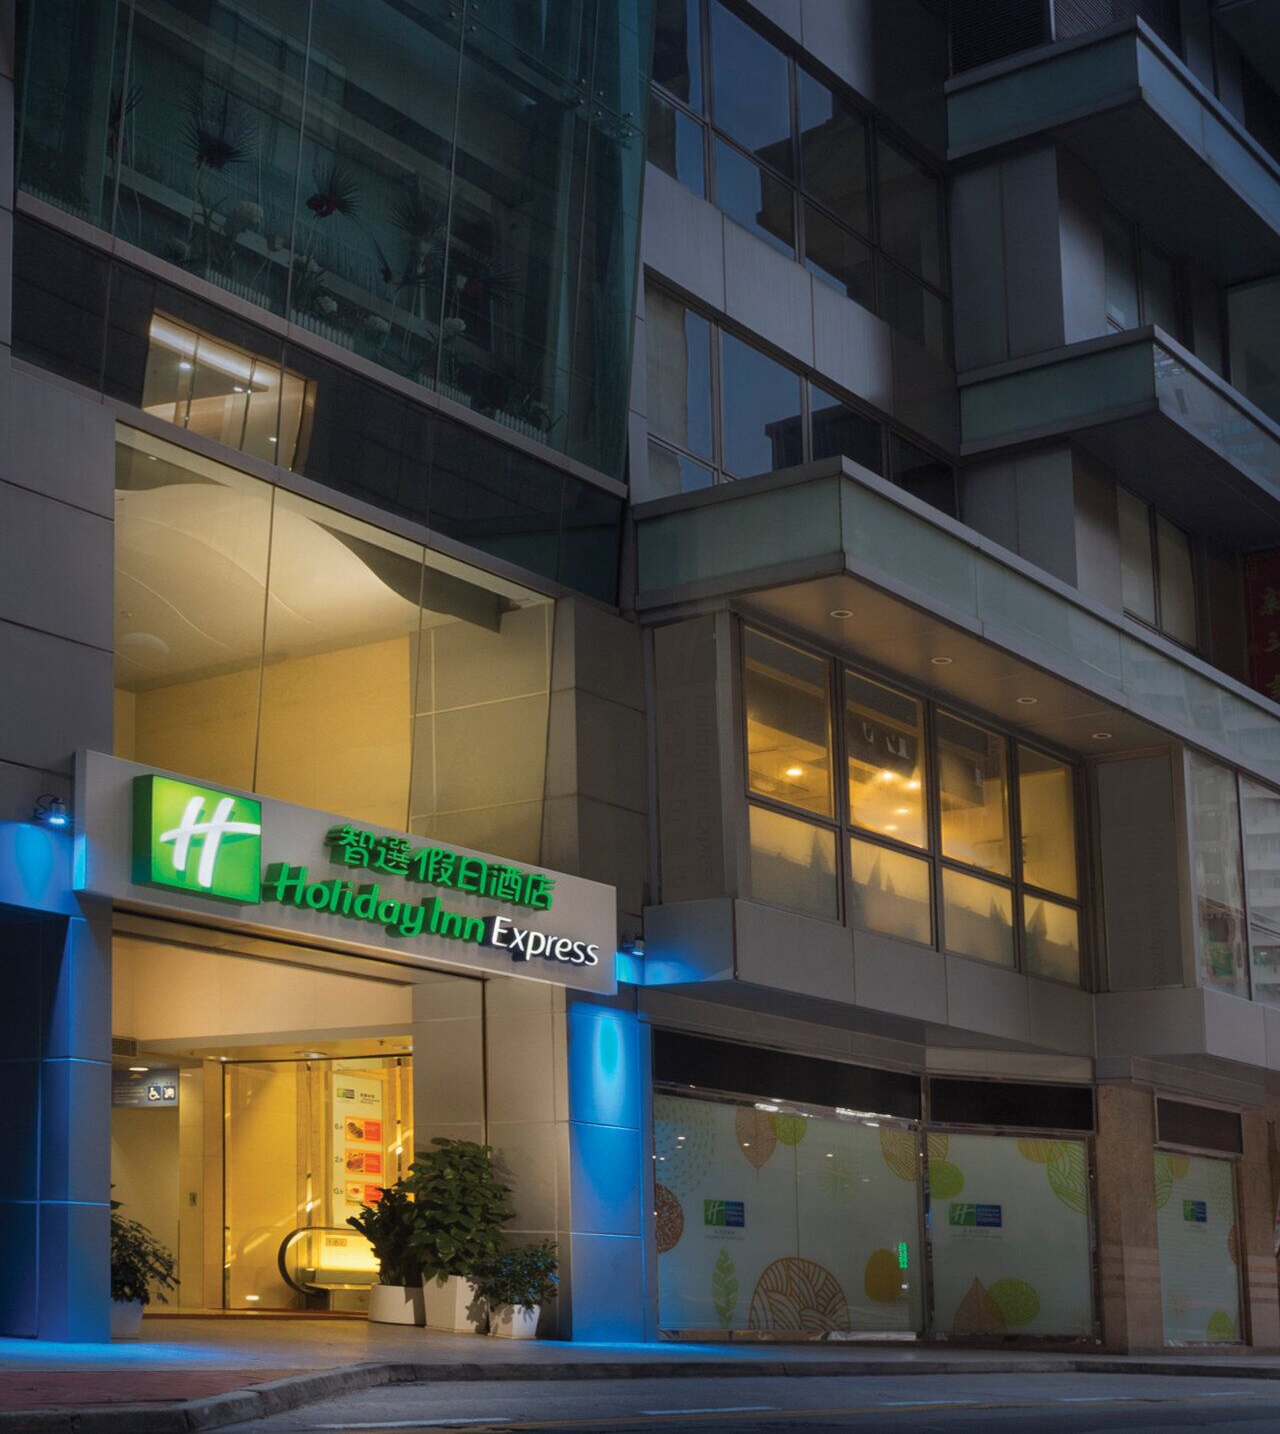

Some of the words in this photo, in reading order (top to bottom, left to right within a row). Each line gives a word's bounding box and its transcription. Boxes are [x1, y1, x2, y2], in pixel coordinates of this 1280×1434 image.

[271, 862, 426, 937] Holiday
[428, 898, 486, 944] Inn
[491, 916, 599, 966] Express
[333, 824, 556, 911] 智選假日酒店
